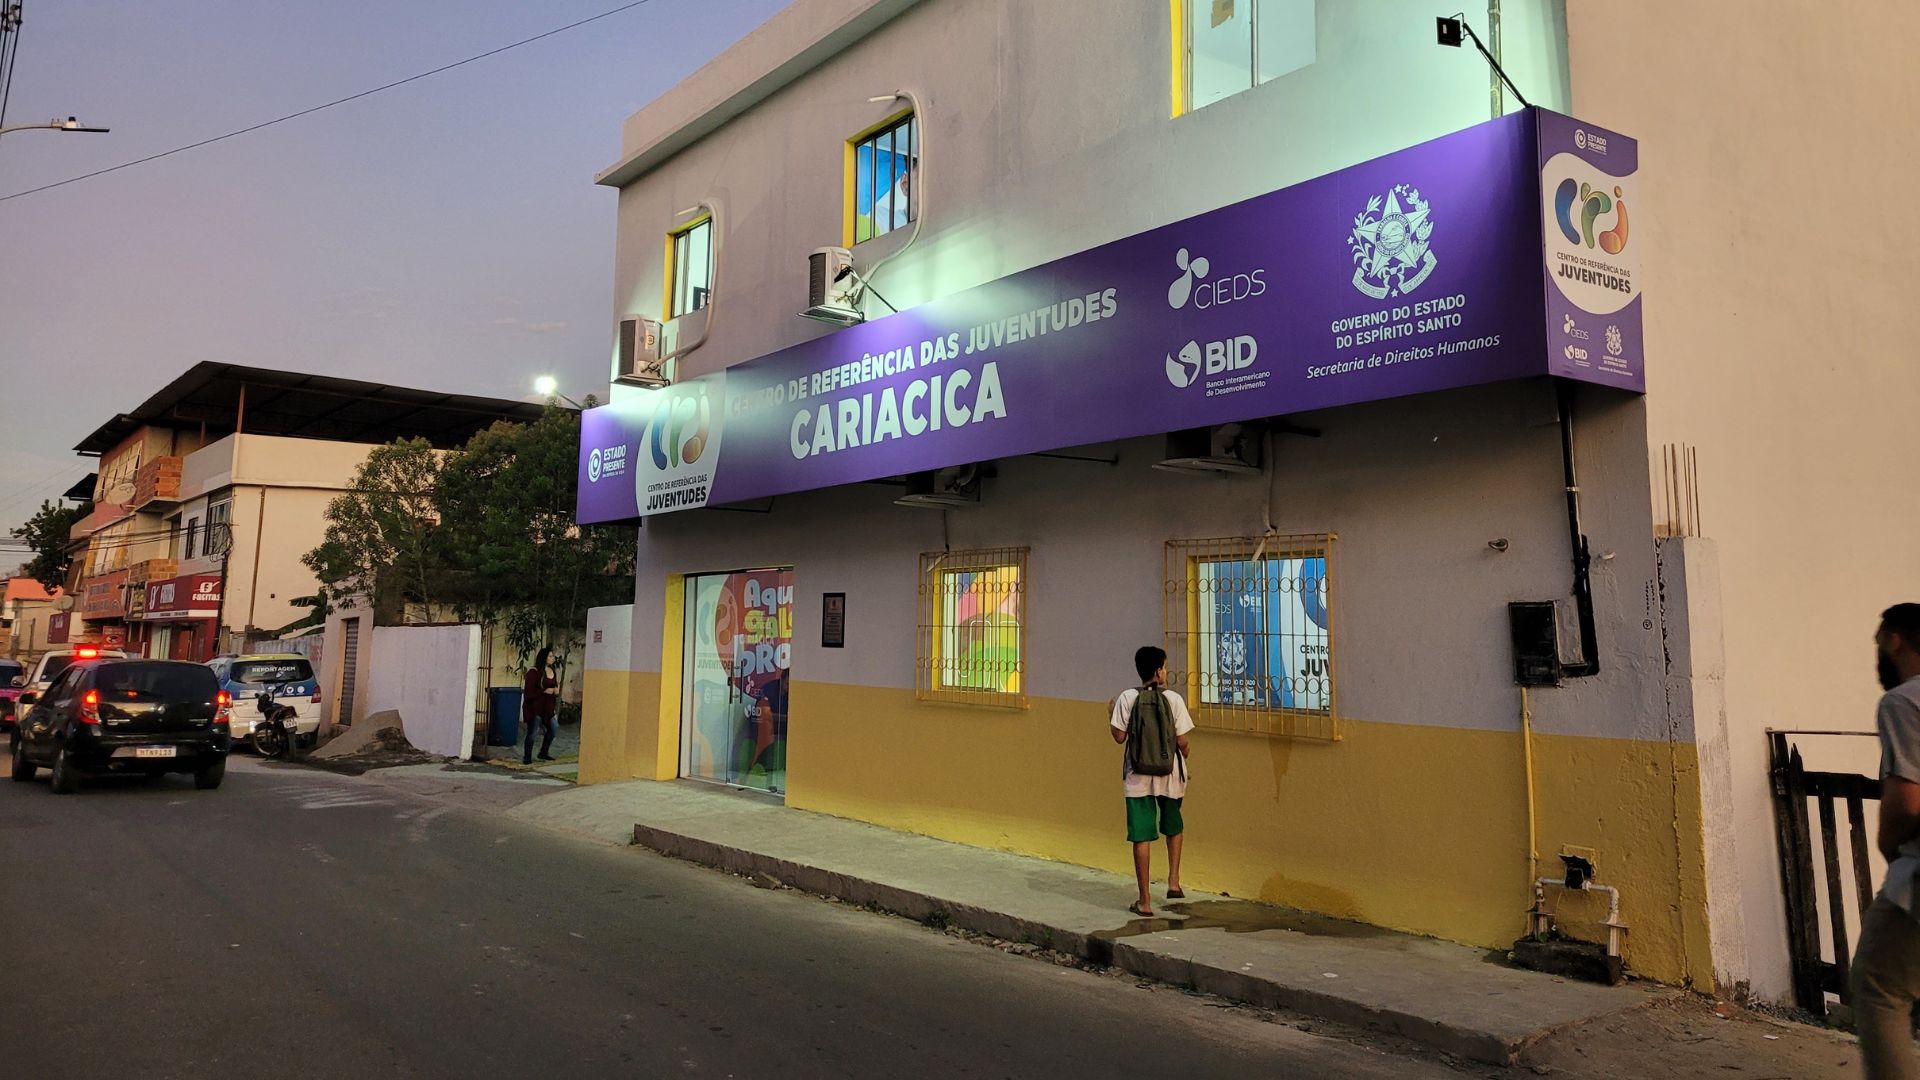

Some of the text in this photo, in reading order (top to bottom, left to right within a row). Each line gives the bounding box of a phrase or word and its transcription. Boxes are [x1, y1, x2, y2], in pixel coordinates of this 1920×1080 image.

[1556, 252, 1631, 278] CENTRO DE REFERÊNCIA DAS
[1558, 262, 1631, 294] JUVENTUDES
[1194, 269, 1266, 309] CIEDS
[1332, 294, 1466, 333] GOVERNO DO ESTADO
[788, 377, 808, 402] DE
[812, 346, 916, 396] REFERÊNCIA
[920, 333, 960, 367] DAS
[965, 288, 1118, 355] JUVENTUDES
[1336, 313, 1462, 349] DO ESPÍRITO SANTO
[1205, 334, 1258, 376] BID
[1307, 334, 1500, 379] Secretaria de Direitos Humanos
[1574, 348, 1588, 360] BID
[1206, 380, 1225, 388] Banco
[1215, 380, 1266, 396] Desenvolvimento
[790, 362, 1007, 460] CARIACICA
[602, 458, 626, 472] PRESENTE
[604, 444, 626, 460] ESTADO
[648, 474, 708, 492] CENTRO DE REFERÊNCIA DAS
[646, 486, 706, 510] JUVENTUDES
